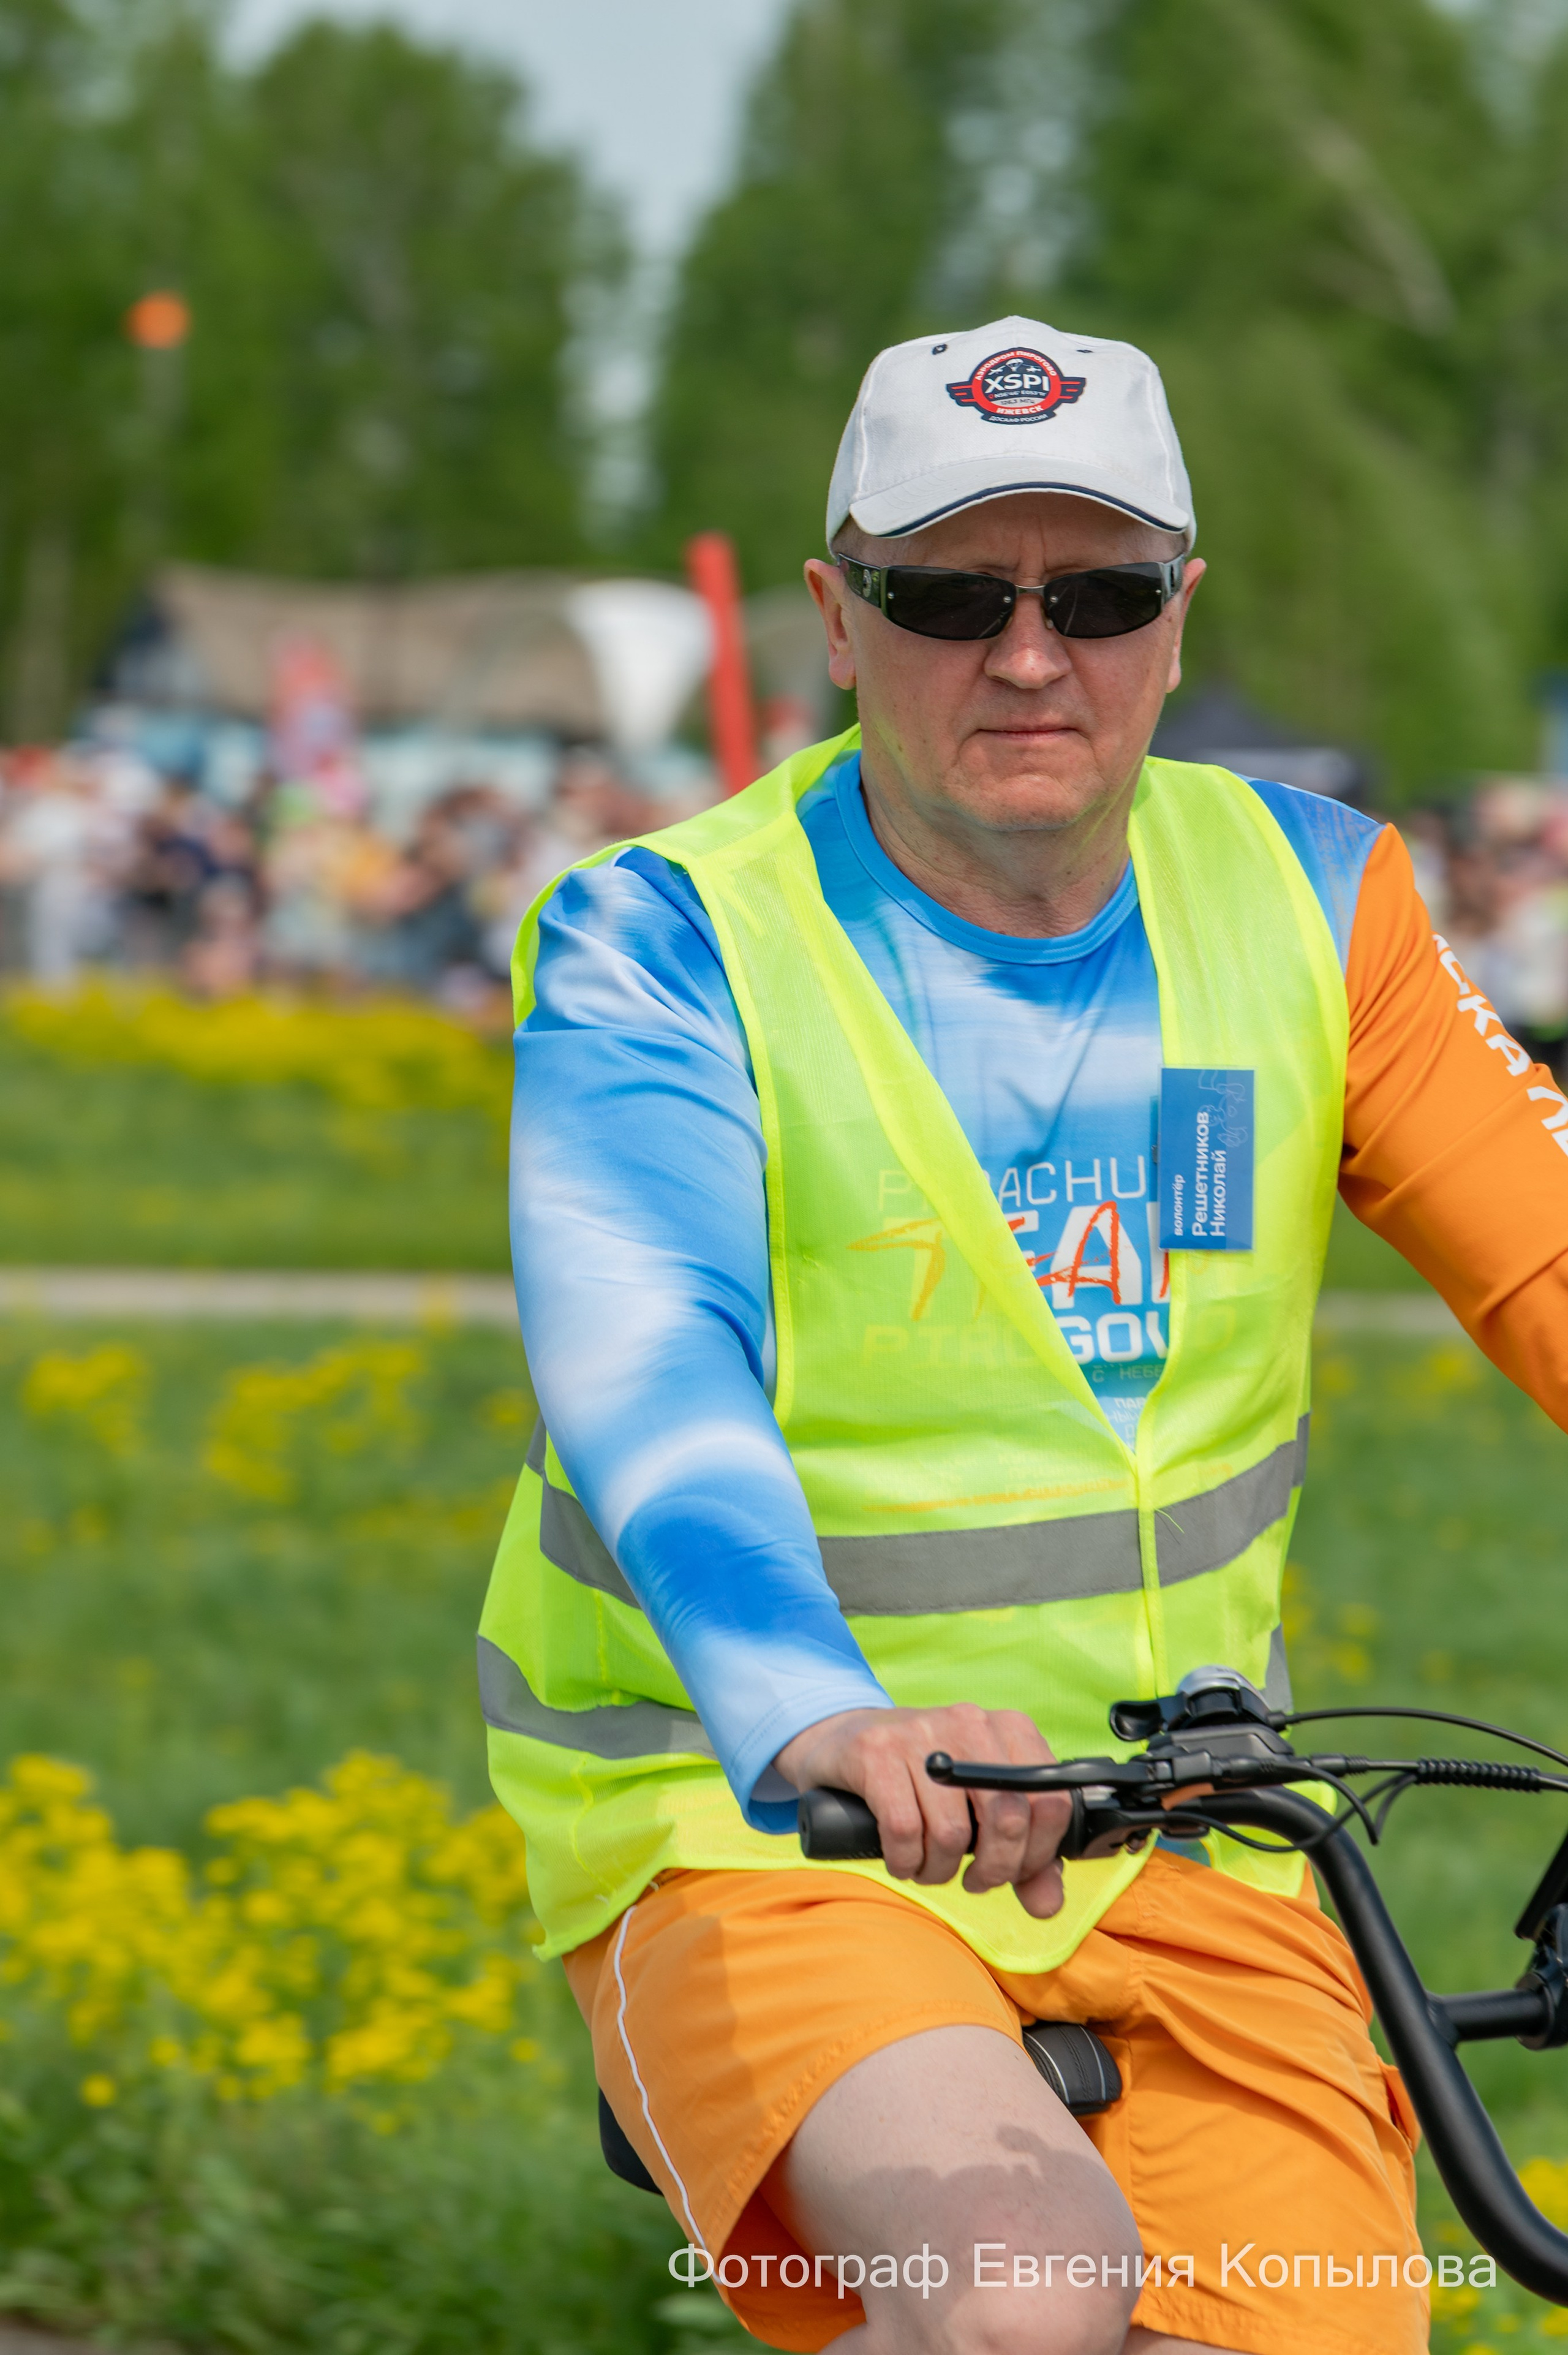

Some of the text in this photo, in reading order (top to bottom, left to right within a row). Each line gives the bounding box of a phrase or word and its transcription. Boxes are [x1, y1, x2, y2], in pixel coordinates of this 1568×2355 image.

[984, 374, 1050, 393] XSPI
[996, 405, 1044, 415] ИЖЕВСК
[1191, 1111, 1210, 1236] Решетников
[1210, 1149, 1227, 1236] Николай
